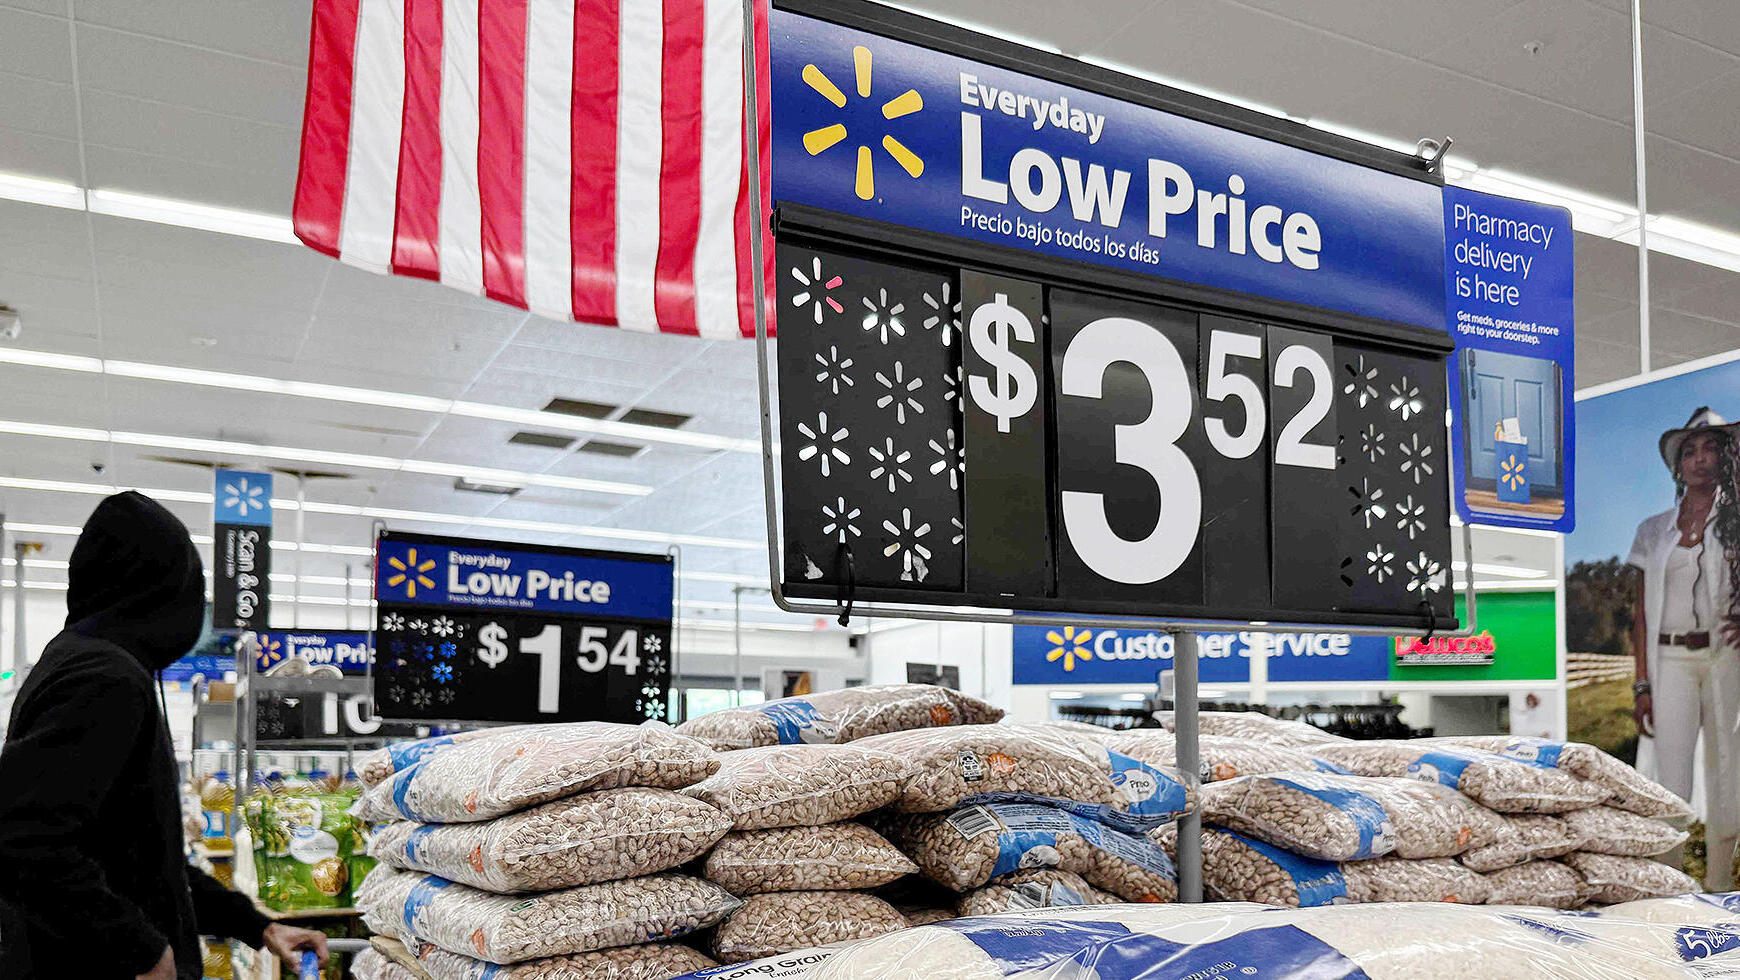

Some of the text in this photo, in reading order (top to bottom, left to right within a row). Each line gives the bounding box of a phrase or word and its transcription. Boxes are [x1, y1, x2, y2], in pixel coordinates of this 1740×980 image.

[959, 72, 1106, 144] Everyday
[960, 111, 1322, 270] Low Price
[960, 206, 1160, 265] Precio bajo todos los días
[1454, 203, 1554, 250] Pharmacy
[1454, 238, 1533, 280] delivery
[1455, 271, 1520, 306] is here
[1456, 310, 1560, 336] Get meds, groceries & more
[1457, 322, 1541, 345] right to your doorstep.
[968, 293, 1038, 433] $
[1061, 317, 1202, 585] 3
[236, 529, 260, 618] Scan & Go
[449, 550, 511, 571] Everyday
[448, 564, 522, 597] Low
[527, 569, 611, 604] Price
[286, 643, 376, 664] Low Pric
[1238, 630, 1350, 658] Service
[477, 621, 508, 669] $
[519, 624, 562, 714] 1
[1683, 929, 1712, 961] 5
